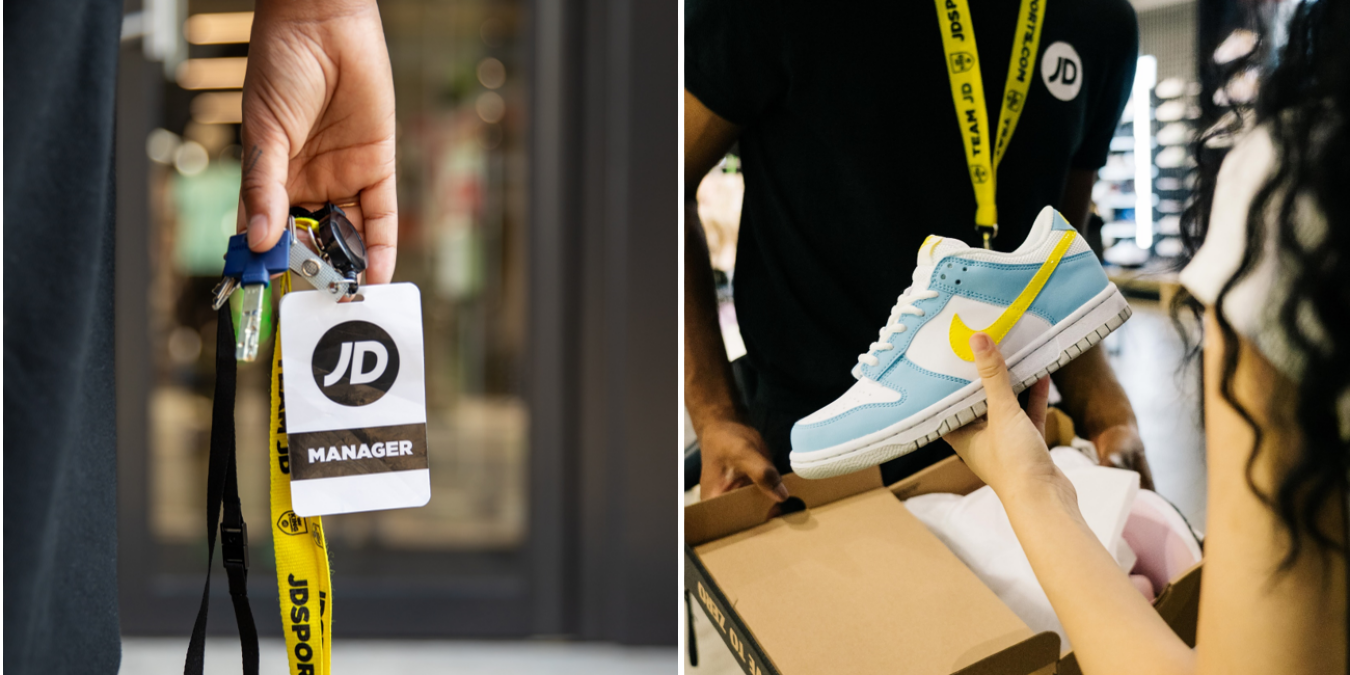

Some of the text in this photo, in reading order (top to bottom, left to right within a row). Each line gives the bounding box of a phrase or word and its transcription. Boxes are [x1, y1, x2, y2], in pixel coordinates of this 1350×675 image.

[1017, 0, 1040, 82] ORTS.COM
[961, 83, 974, 103] JD
[1048, 56, 1077, 85] JD
[965, 109, 981, 157] TEAM
[323, 340, 389, 387] JD
[307, 440, 413, 464] MANAGER
[288, 573, 315, 675] JDSPOR
[697, 581, 726, 634] ZERO
[729, 627, 746, 663] TO
